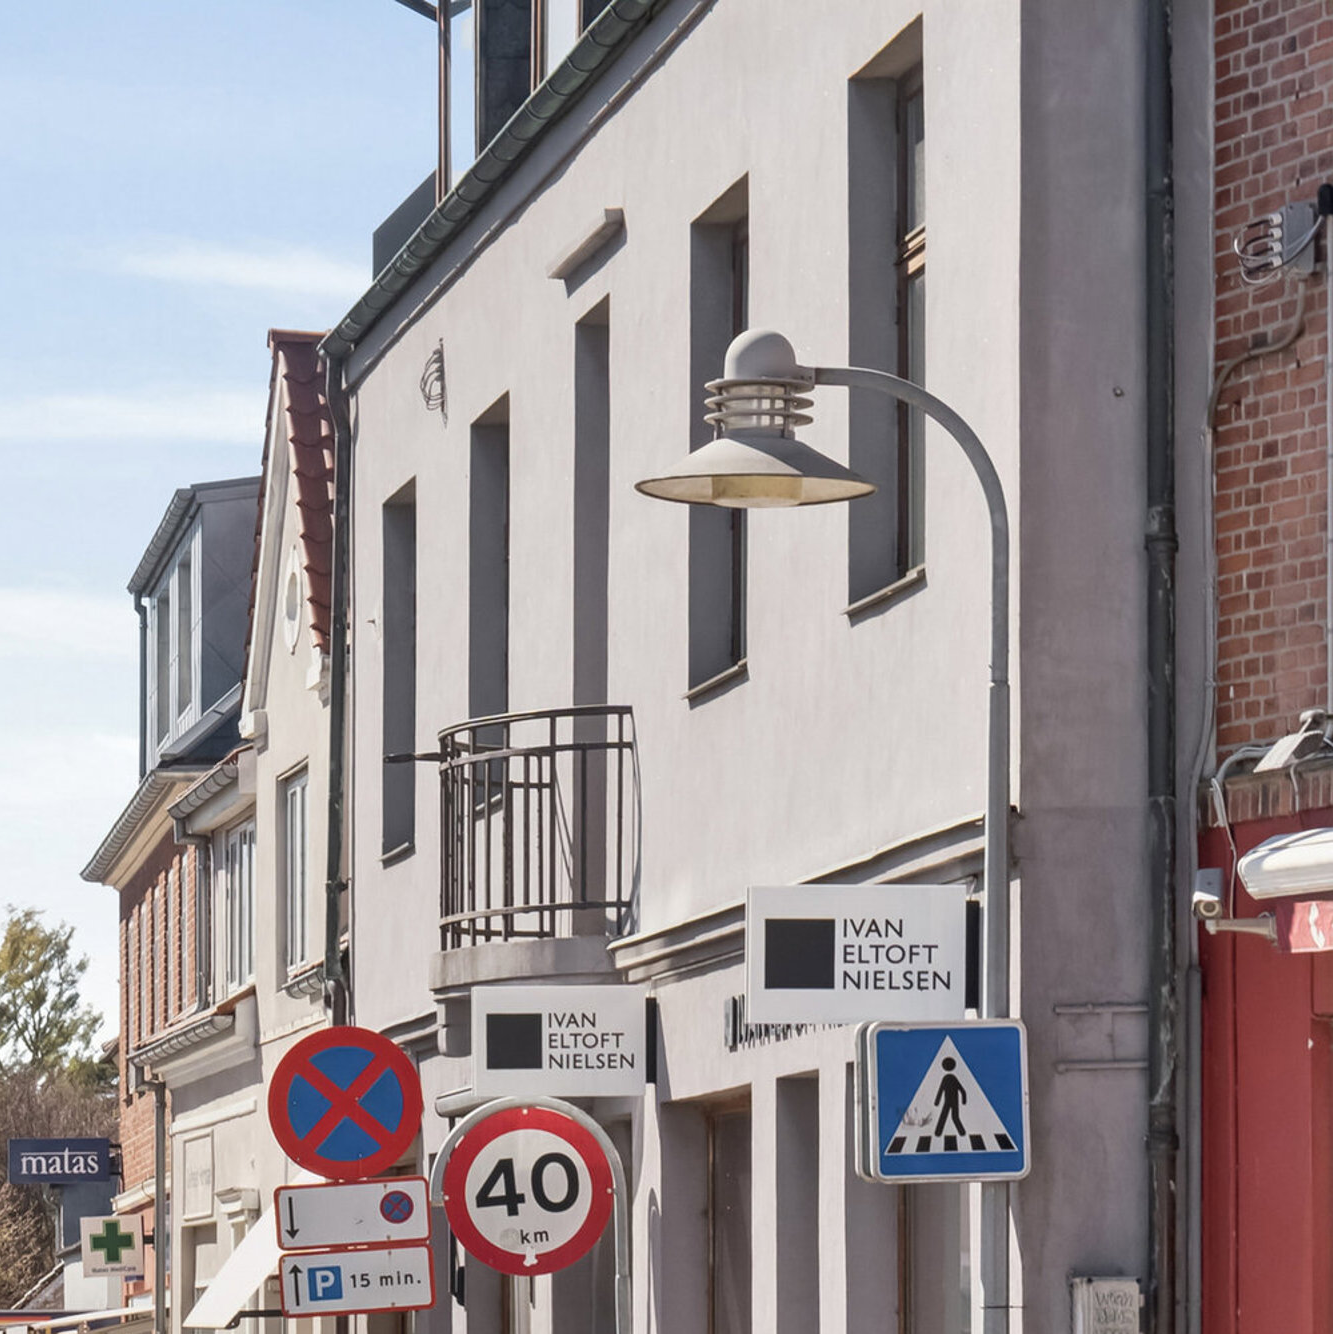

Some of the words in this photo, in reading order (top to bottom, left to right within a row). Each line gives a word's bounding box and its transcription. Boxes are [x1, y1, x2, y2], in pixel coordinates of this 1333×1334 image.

[842, 918, 903, 939] IVAN
[842, 944, 938, 965] ELTOFT
[842, 970, 951, 991] NIELSEN
[547, 1012, 597, 1029] IVAN
[547, 1032, 625, 1050] ELTOFT
[547, 1052, 635, 1070] NIELSEN
[20, 1147, 100, 1175] matas
[474, 1151, 580, 1217] 40
[520, 1227, 550, 1245] km
[314, 1269, 335, 1298] P
[350, 1273, 371, 1289] 15
[379, 1270, 422, 1287] min.
